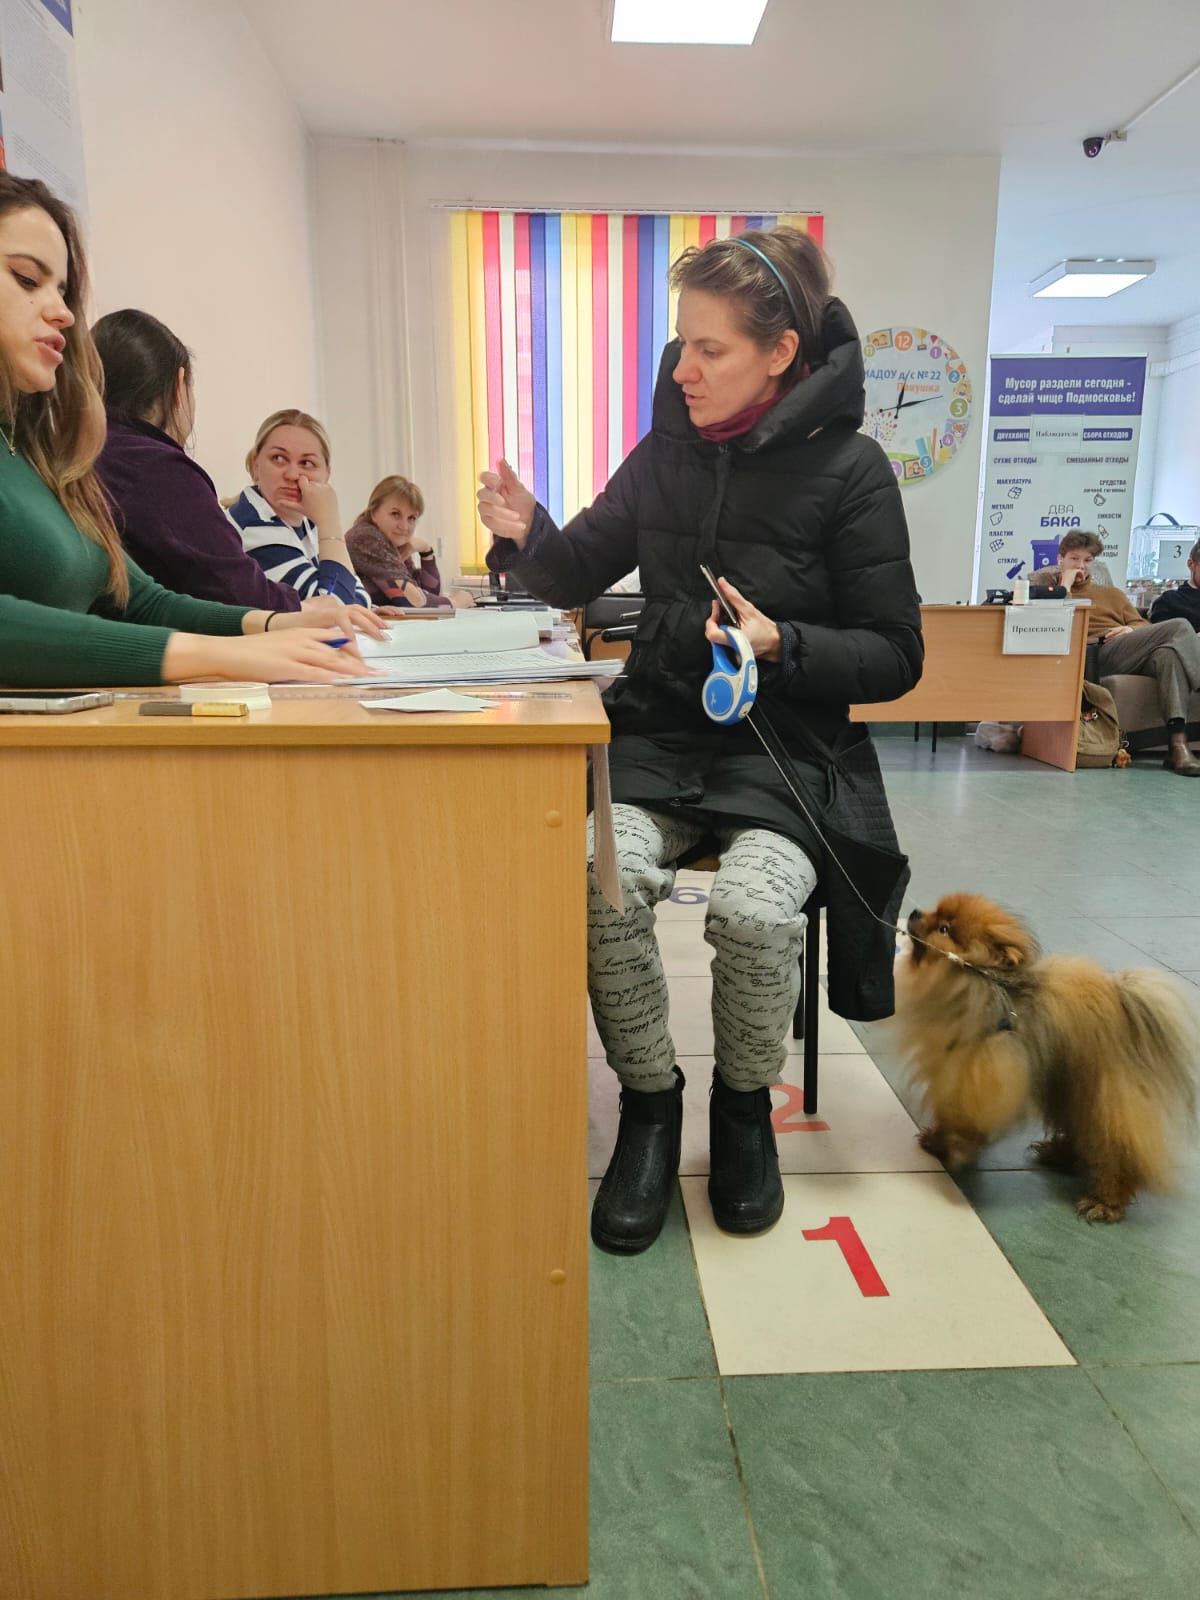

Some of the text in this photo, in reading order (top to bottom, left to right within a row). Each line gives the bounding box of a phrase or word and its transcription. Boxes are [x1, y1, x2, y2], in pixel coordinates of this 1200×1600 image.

[897, 334, 910, 347] 12
[917, 370, 929, 380] №
[930, 371, 941, 380] 22
[1005, 377, 1036, 391] Мусор
[1040, 378, 1082, 390] раздели
[1084, 378, 1124, 389] сегодня
[998, 391, 1136, 404] сделай чище Подмосковье!
[955, 401, 963, 413] 3
[996, 431, 1129, 440] ДВУХКОНТЕ СБОРА ОТХОДОВ
[922, 457, 929, 465] 5
[1013, 456, 1037, 465] ОТХОДЫ
[1105, 456, 1129, 464] ОТХОДЫ
[1048, 504, 1074, 515] ДВА
[1040, 516, 1081, 527] БАКА
[1173, 545, 1182, 559] 3
[1012, 625, 1066, 636] Председатель
[668, 886, 709, 905] 6
[769, 1083, 831, 1133] 2
[801, 1216, 890, 1297] 1
